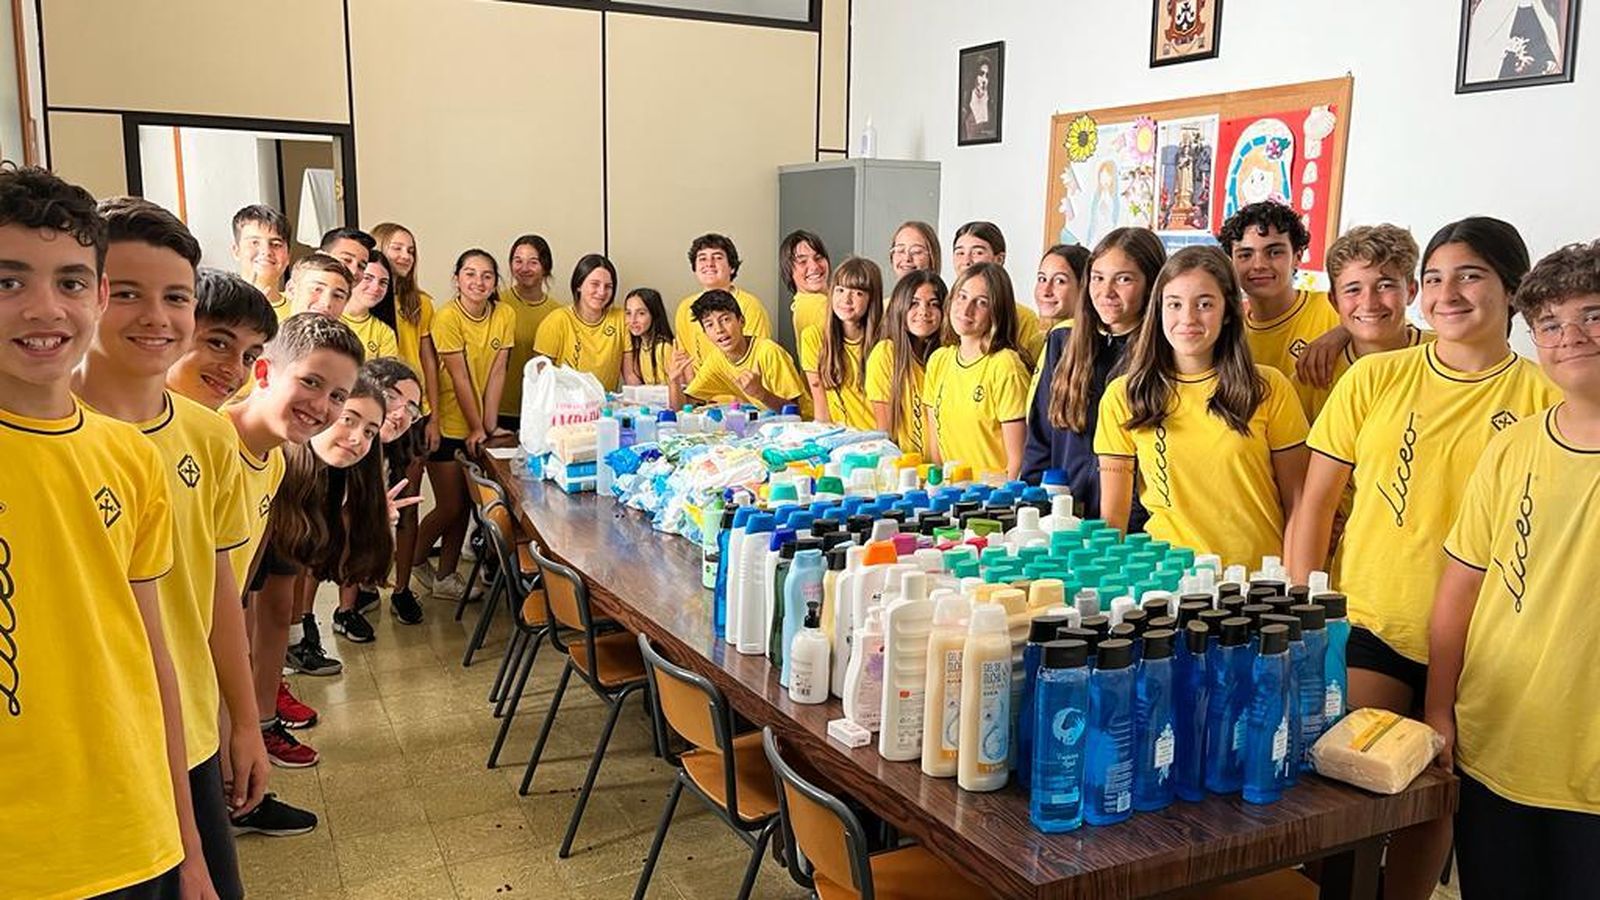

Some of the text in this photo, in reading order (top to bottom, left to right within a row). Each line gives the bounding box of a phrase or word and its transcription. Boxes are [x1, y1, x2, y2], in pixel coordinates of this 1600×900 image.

[1151, 420, 1173, 508] Liceo
[1376, 411, 1417, 528] Liceo
[1493, 472, 1533, 613] Liceo
